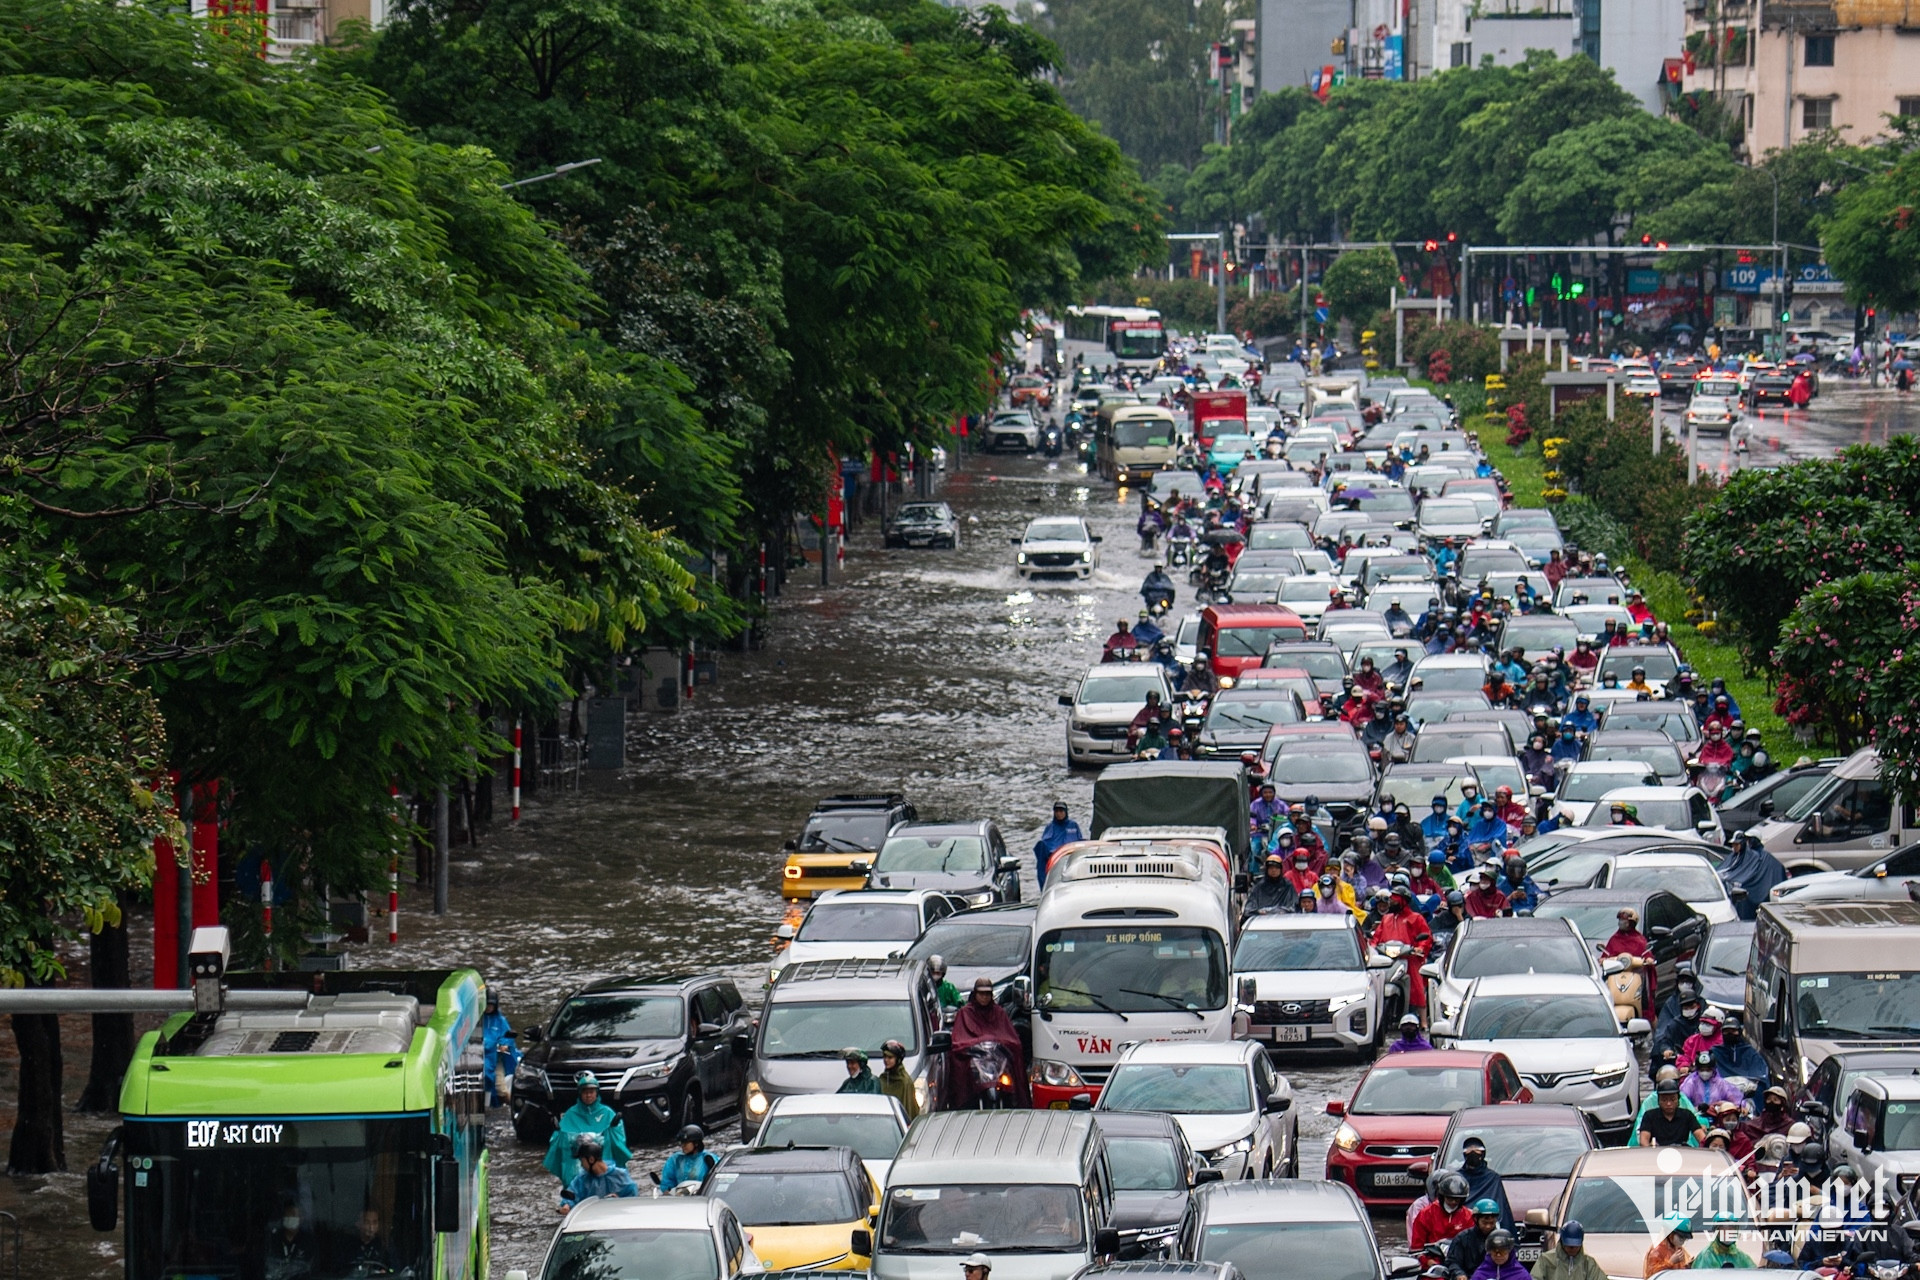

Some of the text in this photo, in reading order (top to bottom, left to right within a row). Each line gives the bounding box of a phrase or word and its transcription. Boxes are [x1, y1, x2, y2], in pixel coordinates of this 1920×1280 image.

[1730, 270, 1757, 284] 109
[1105, 933, 1117, 943] XE
[1077, 1035, 1112, 1053] VĂN
[187, 1120, 220, 1147] E07
[252, 1124, 283, 1144] CITY
